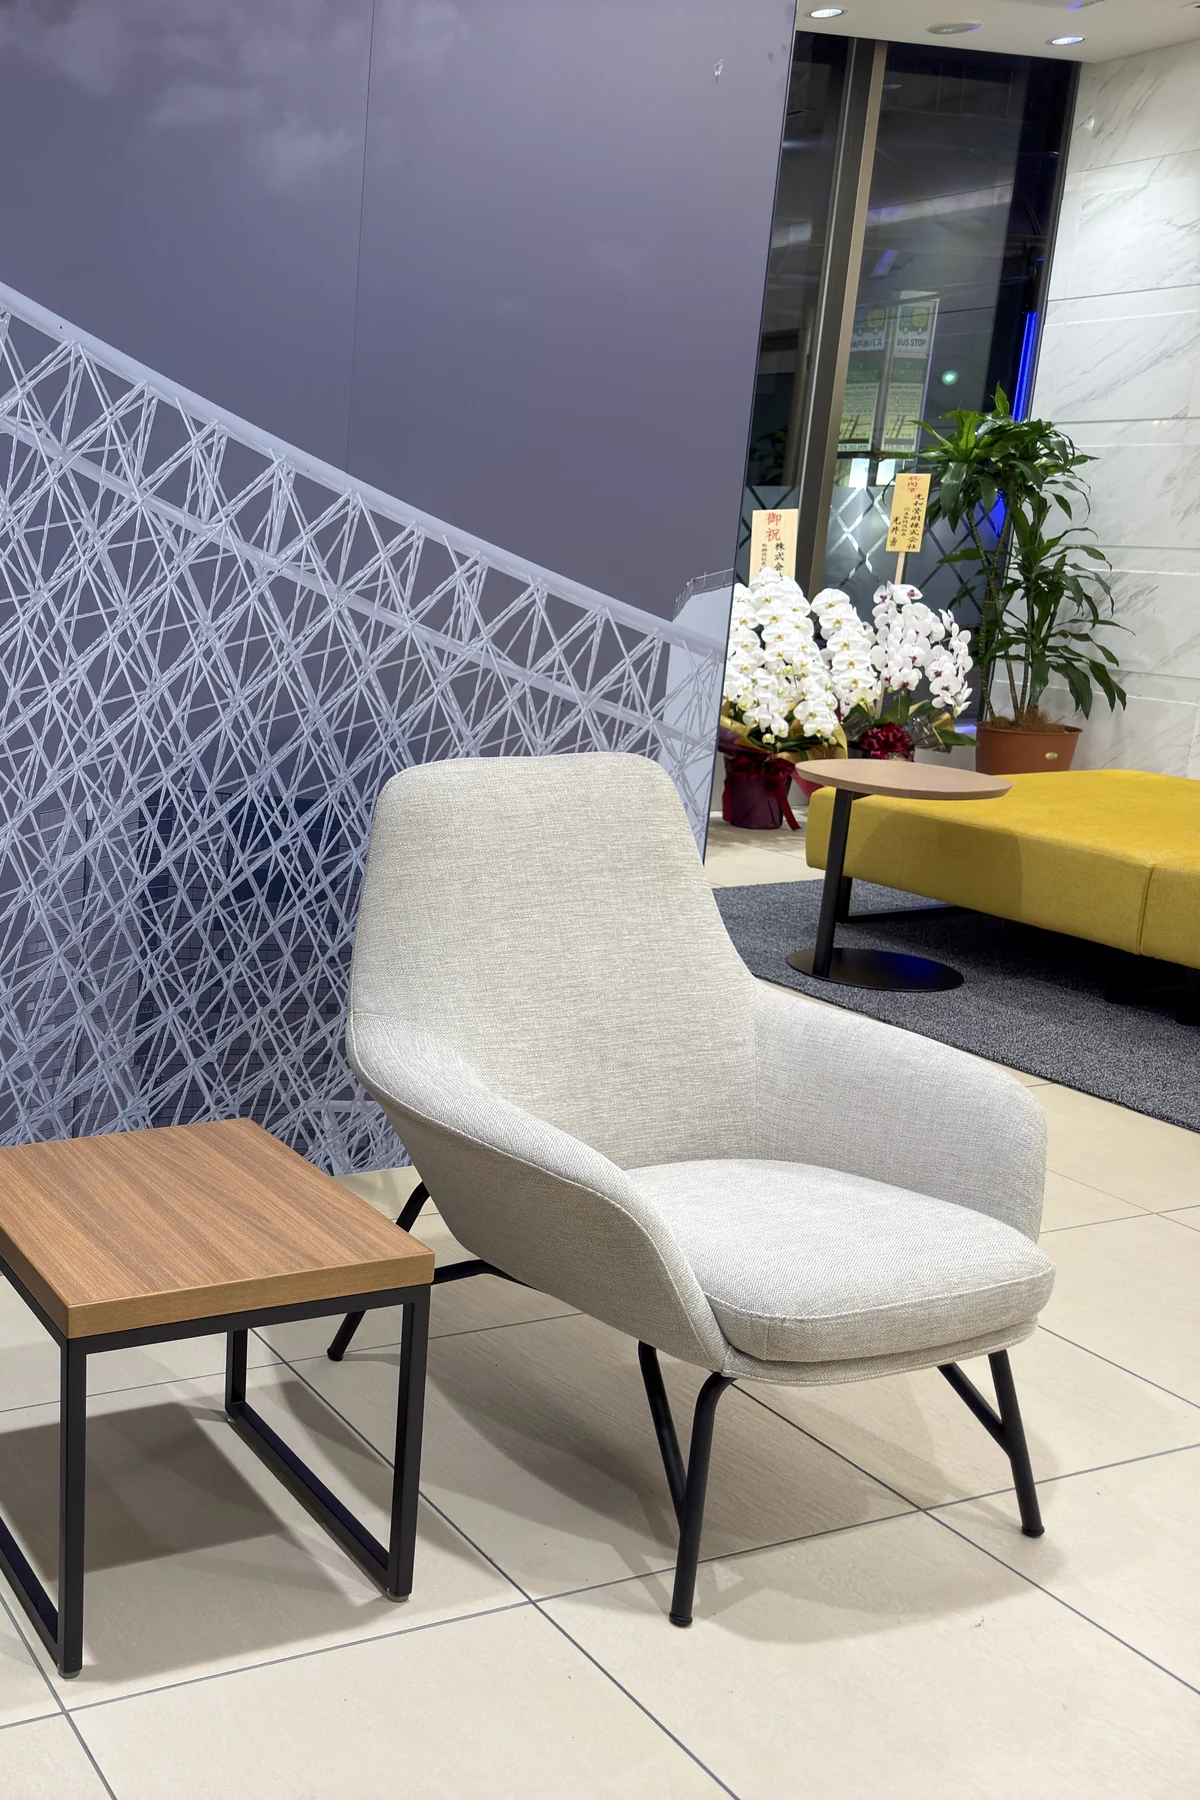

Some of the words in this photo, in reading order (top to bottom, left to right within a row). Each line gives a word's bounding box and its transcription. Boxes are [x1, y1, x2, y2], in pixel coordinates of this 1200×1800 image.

[896, 337, 910, 347] BUS
[910, 337, 927, 347] STOP
[765, 511, 782, 542] 御祝
